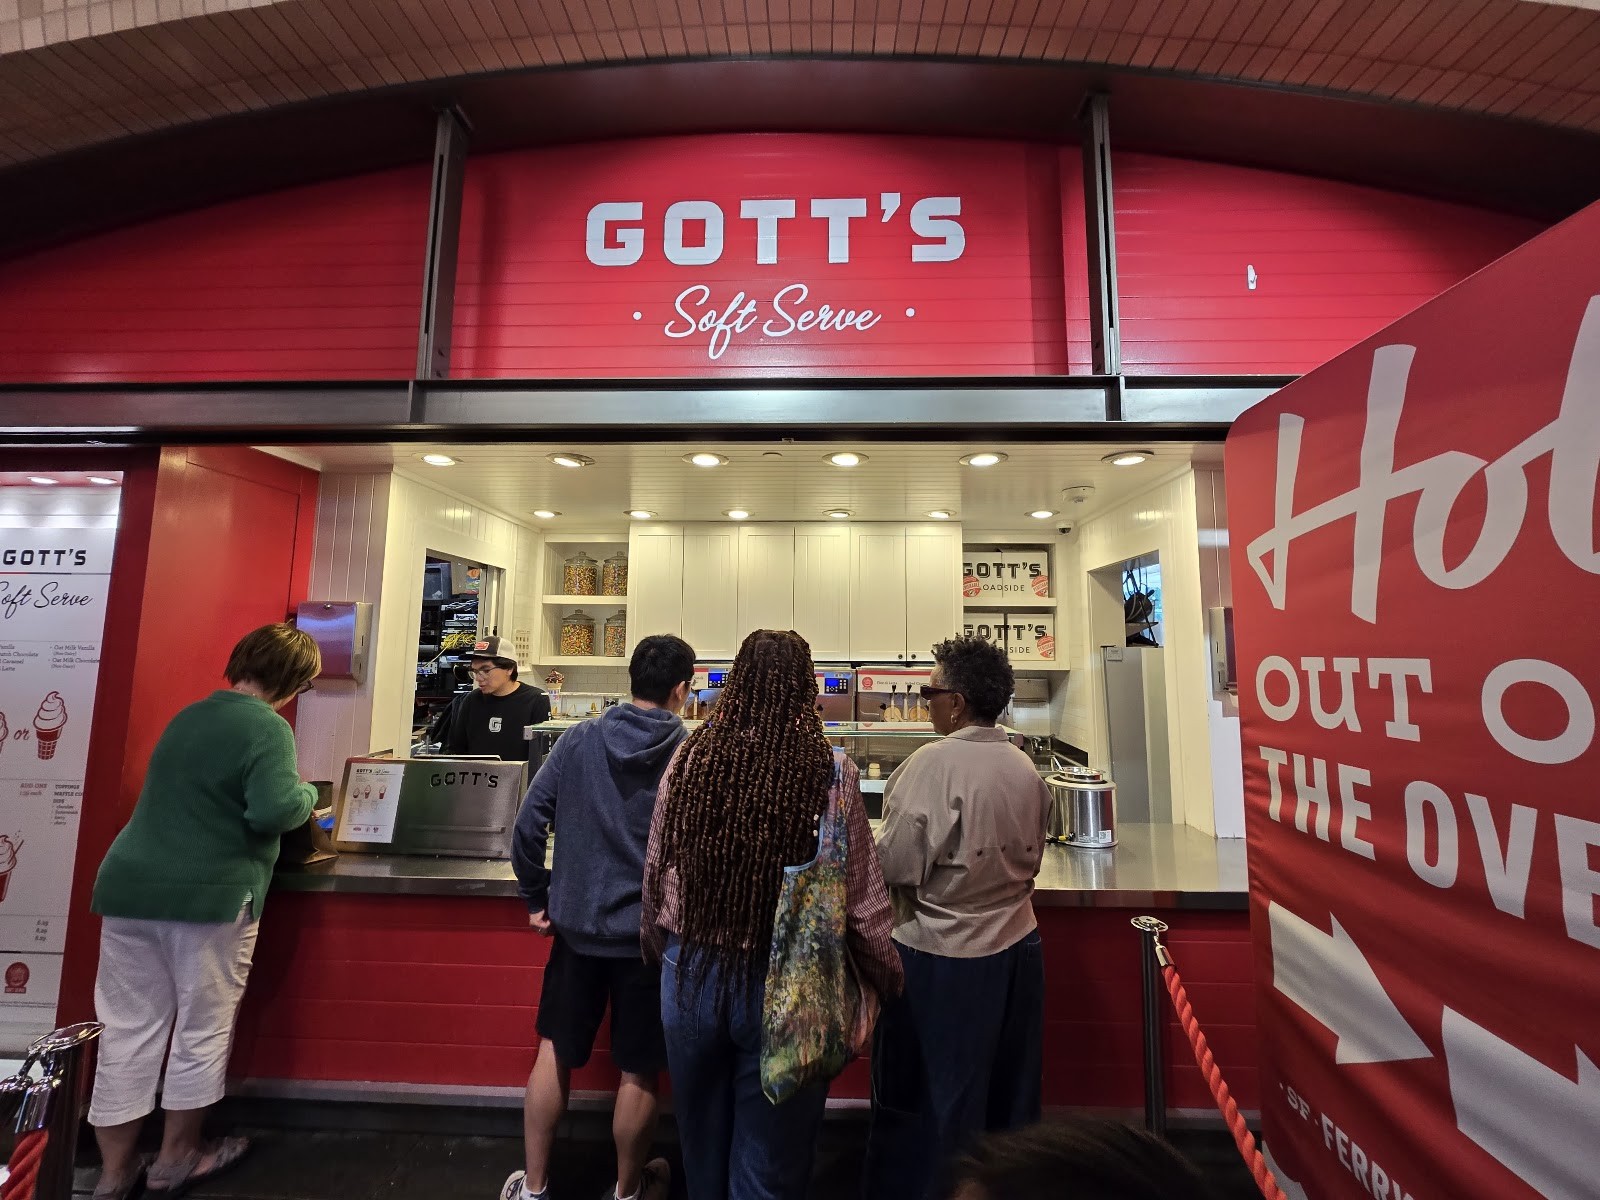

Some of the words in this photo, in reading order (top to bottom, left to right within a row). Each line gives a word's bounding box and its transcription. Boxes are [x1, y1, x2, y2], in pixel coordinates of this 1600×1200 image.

[585, 192, 966, 266] GOTT'S
[664, 284, 757, 360] Soft
[762, 284, 882, 338] Serve
[3, 548, 87, 566] GOTT'S
[963, 562, 1042, 579] GOTT'S
[33, 581, 93, 609] Serve
[982, 584, 1025, 592] OADSIDE
[1255, 655, 1433, 743] OUT
[1481, 658, 1596, 765] O
[488, 716, 503, 733] G
[15, 728, 30, 741] or
[430, 771, 499, 789] GOTT'S
[1258, 745, 1377, 862] THE
[1404, 780, 1600, 951] OVE
